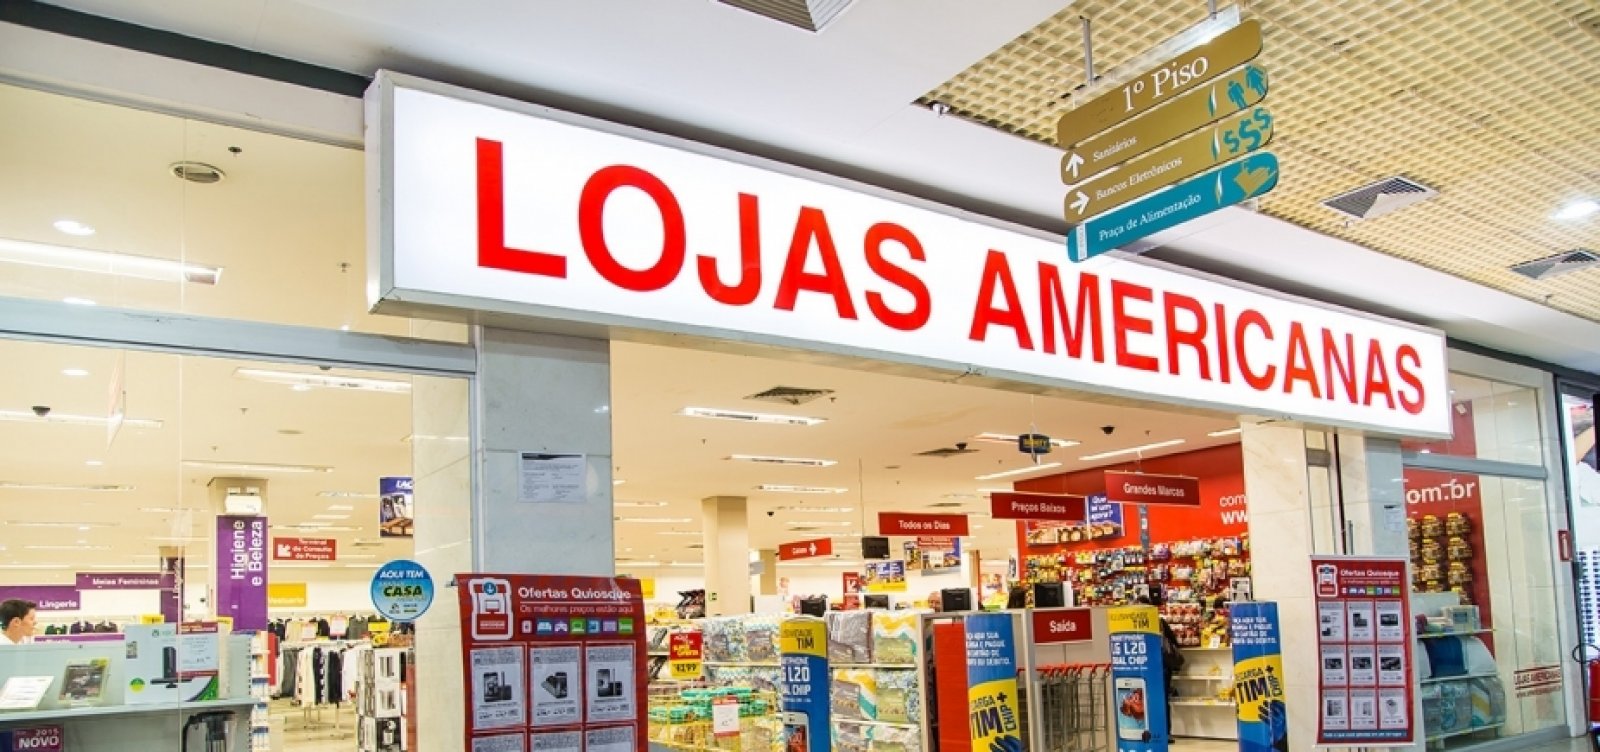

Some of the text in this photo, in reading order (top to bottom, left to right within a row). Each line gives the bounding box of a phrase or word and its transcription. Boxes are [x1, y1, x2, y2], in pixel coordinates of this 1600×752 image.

[1123, 56, 1209, 113] 1º Piso
[1093, 136, 1138, 162] Sanitários
[1096, 156, 1182, 201] Bancos Eletrônicos
[1099, 194, 1201, 241] Praça de Alimentação
[476, 137, 1425, 415] LOJAS AMERICANAS
[1123, 482, 1185, 498] Grandes Marcas
[1011, 501, 1066, 514] Preços Baixos
[898, 520, 921, 529] Todos
[934, 520, 950, 529] Dias
[231, 520, 248, 580] Higiene
[248, 521, 263, 587] e Beleza
[380, 570, 424, 579] AQUI TEM
[383, 585, 423, 597] CASA
[518, 587, 632, 601] Ofertas Quiosque
[39, 600, 77, 609] Lingerie
[520, 604, 634, 614] Os melhores preços estão aqui
[1050, 619, 1077, 633] Saída
[1133, 618, 1149, 628] TIM
[797, 638, 814, 649] TIM
[1125, 642, 1146, 655] L20
[1128, 656, 1149, 665] CHIP
[788, 667, 809, 682] L20
[792, 684, 811, 696] CHIP
[1236, 677, 1271, 705] TIM
[19, 736, 60, 749] NOVO
